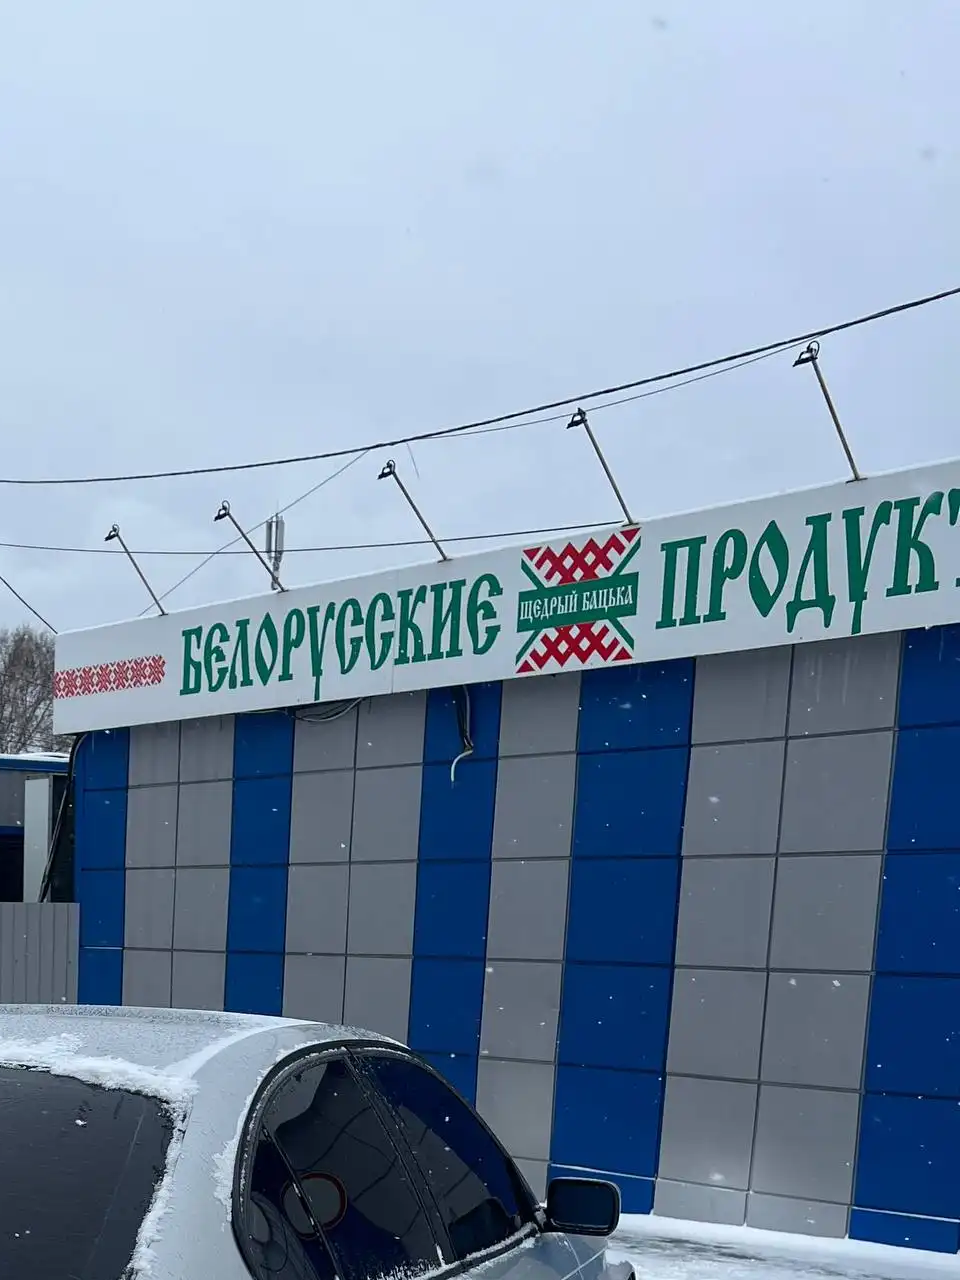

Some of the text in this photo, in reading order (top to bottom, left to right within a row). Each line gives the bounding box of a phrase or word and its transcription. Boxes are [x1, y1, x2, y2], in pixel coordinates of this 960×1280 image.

[520, 584, 633, 623] ЩЕДРЫЙ БАЦЬКА
[655, 488, 960, 635] ПРОДУК
[180, 573, 503, 701] БЕЛОРУССКИЕ
